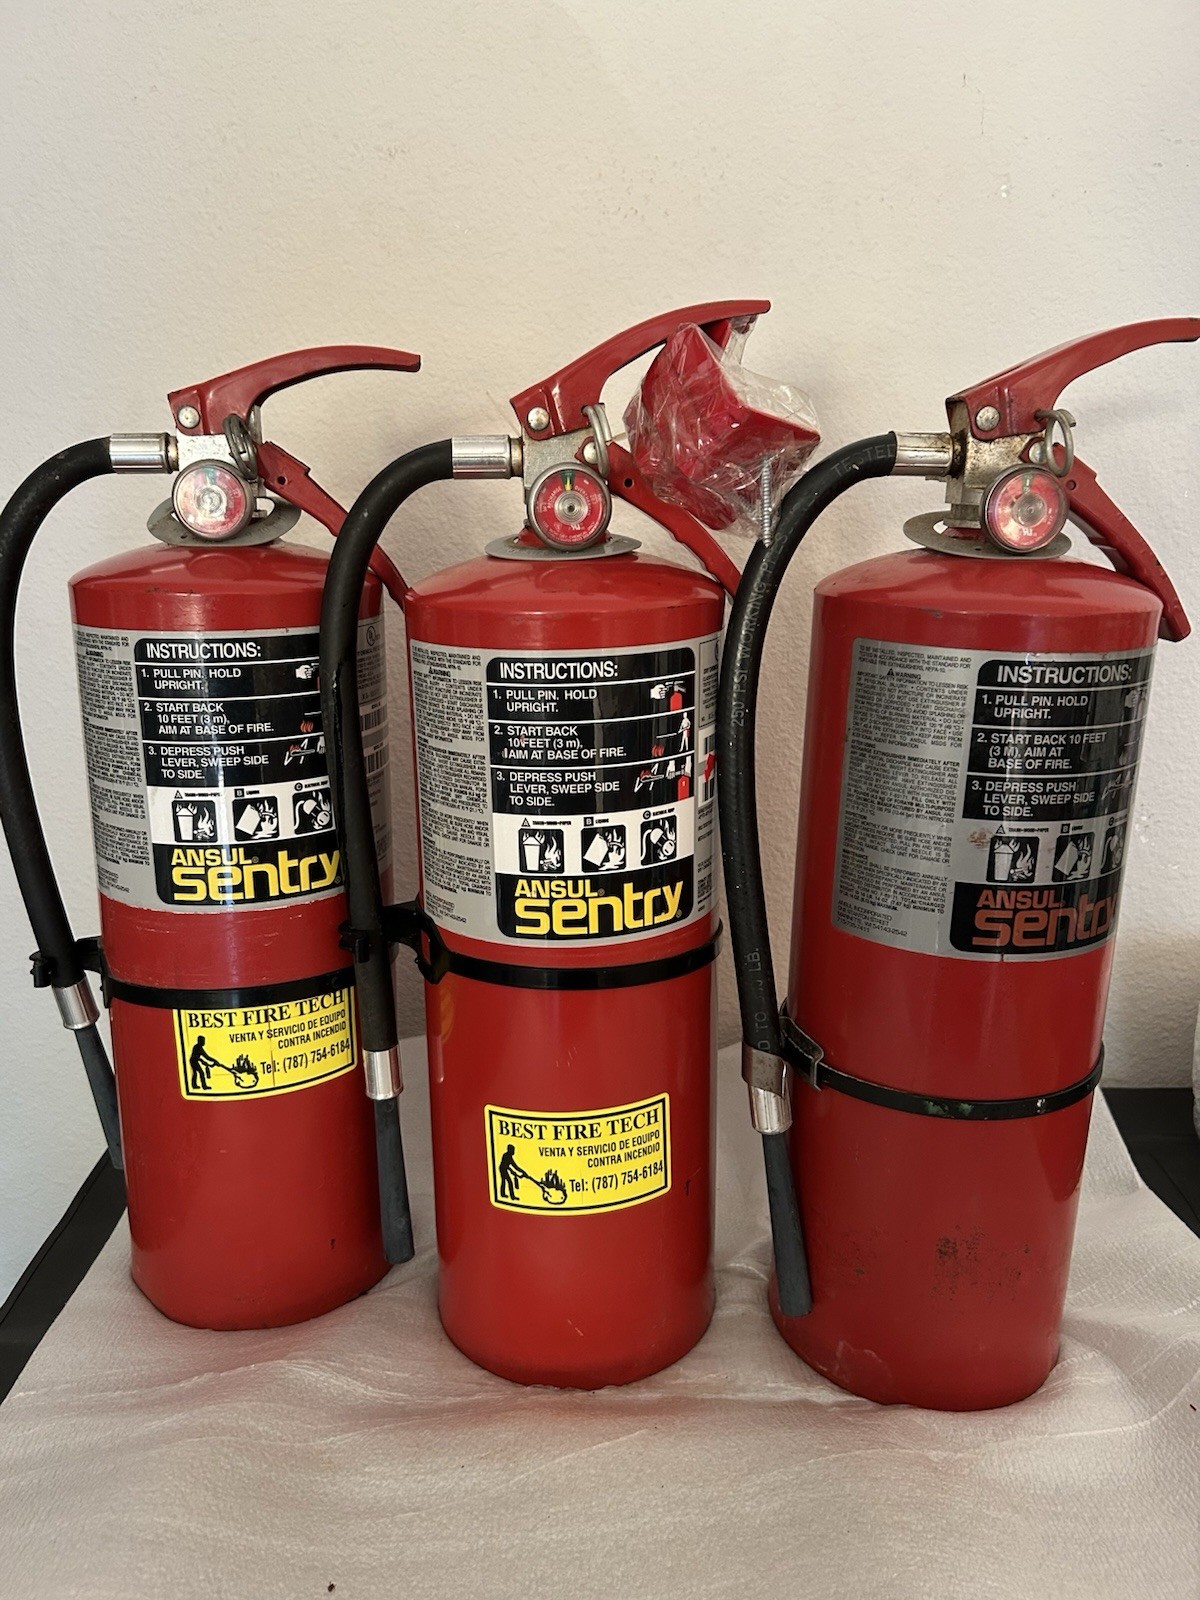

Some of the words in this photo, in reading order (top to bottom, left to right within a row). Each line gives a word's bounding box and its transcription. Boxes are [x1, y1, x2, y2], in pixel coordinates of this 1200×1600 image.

[736, 581, 767, 662] WORKING
[147, 642, 261, 659] INSTRUCTIONS:
[142, 669, 149, 678] 1.
[153, 669, 181, 679] PULL
[183, 669, 204, 678] PIN.
[209, 668, 241, 678] HOLD
[500, 662, 618, 679] INSTRUCTIONS:
[997, 664, 1132, 684] INSTRUCTIONS:
[155, 680, 204, 691] UPRIGHT.
[733, 669, 748, 693] PSI
[493, 690, 501, 699] 1.
[506, 690, 535, 700] PULL
[538, 690, 559, 700] PIN.
[564, 689, 597, 700] HOLD
[982, 695, 992, 704] 1.
[995, 695, 1029, 705] PULL
[1031, 695, 1054, 706] PIN.
[1057, 695, 1088, 707] HOLD
[144, 703, 152, 711] 2.
[156, 703, 190, 713] START
[193, 703, 224, 712] BACK
[507, 701, 558, 712] UPRIGHT.
[157, 714, 168, 723] 10
[170, 714, 198, 723] FEET
[200, 714, 211, 724] (3
[730, 701, 745, 727] 250
[994, 708, 1051, 719] UPRIGHT.
[159, 725, 178, 734] AIM
[180, 725, 193, 734] AT
[195, 725, 226, 735] BASE
[228, 724, 244, 734] OF
[247, 723, 274, 733] FIRE.
[494, 726, 503, 734] 2.
[507, 726, 543, 736] START
[545, 726, 577, 736] BACK
[508, 738, 520, 747] 10
[524, 738, 550, 748] FEET
[553, 737, 563, 749] (3
[977, 733, 988, 743] 2.
[991, 732, 1031, 744] START
[1034, 733, 1065, 745] BACK
[1069, 733, 1080, 744] 10
[1083, 732, 1106, 743] FEET
[148, 747, 156, 755] 3.
[160, 746, 211, 756] DEPRESS
[214, 746, 244, 756] PUSH
[509, 749, 529, 759] AIM
[531, 750, 543, 759] AT
[547, 749, 578, 760] BASE
[581, 749, 597, 759] OF
[599, 747, 626, 758] FIRE.
[989, 746, 1001, 758] (3
[1024, 747, 1047, 758] AIM
[1049, 747, 1064, 757] AT
[162, 757, 198, 768] LEVER,
[201, 756, 241, 767] SWEEP
[243, 755, 268, 765] SIDE
[988, 758, 1022, 769] BASE
[1025, 759, 1042, 770] OF
[1044, 759, 1072, 769] FIRE.
[161, 769, 175, 779] TO
[178, 769, 204, 778] SIDE.
[496, 772, 505, 781] 3.
[510, 772, 563, 782] DEPRESS
[565, 771, 596, 781] PUSH
[510, 783, 549, 795] LEVER,
[551, 782, 592, 793] SWEEP
[594, 781, 620, 792] SIDE
[972, 781, 982, 790] 3.
[985, 781, 1044, 792] DEPRESS
[1046, 781, 1076, 792] PUSH
[510, 796, 524, 805] TO
[526, 796, 554, 806] SIDE.
[984, 793, 1027, 805] LEVER,
[1031, 793, 1071, 804] SWEEP
[1073, 792, 1094, 803] SIDE
[983, 805, 999, 816] TO
[1003, 805, 1033, 817] SIDE.
[929, 815, 954, 823] NITROGEN
[172, 848, 252, 866] ANSUL
[172, 851, 340, 901] sentry
[515, 880, 598, 898] ANSUL
[977, 890, 1061, 908] ANSUL
[515, 881, 683, 935] sentry
[972, 893, 1118, 946] sentry
[188, 1013, 237, 1028] BEST
[244, 1005, 291, 1026] FIRE
[295, 990, 345, 1016] TECH
[229, 1032, 256, 1043] VENTA
[267, 1025, 305, 1039] SERVICIO
[308, 1021, 318, 1029] DE
[320, 1009, 346, 1027] EQUIPO
[278, 1036, 311, 1049] CONTRA
[313, 1021, 346, 1041] INCENDIO
[260, 1061, 280, 1075] Tel:
[283, 1053, 308, 1073] (787)
[311, 1038, 350, 1063] 754-6184
[498, 1120, 547, 1139] BEST
[553, 1123, 602, 1140] FIRE
[607, 1108, 659, 1134] TECH
[539, 1147, 566, 1157] VENTA
[568, 1148, 574, 1157] Y
[577, 1142, 616, 1156] SERVICIO
[619, 1140, 630, 1149] DE
[632, 1130, 660, 1147] EQUIPO
[588, 1156, 622, 1168] CONTRA
[624, 1142, 660, 1162] INCENDIO
[570, 1179, 589, 1193] Tel:
[592, 1175, 618, 1193] (787)
[622, 1160, 663, 1186] 754-6184
